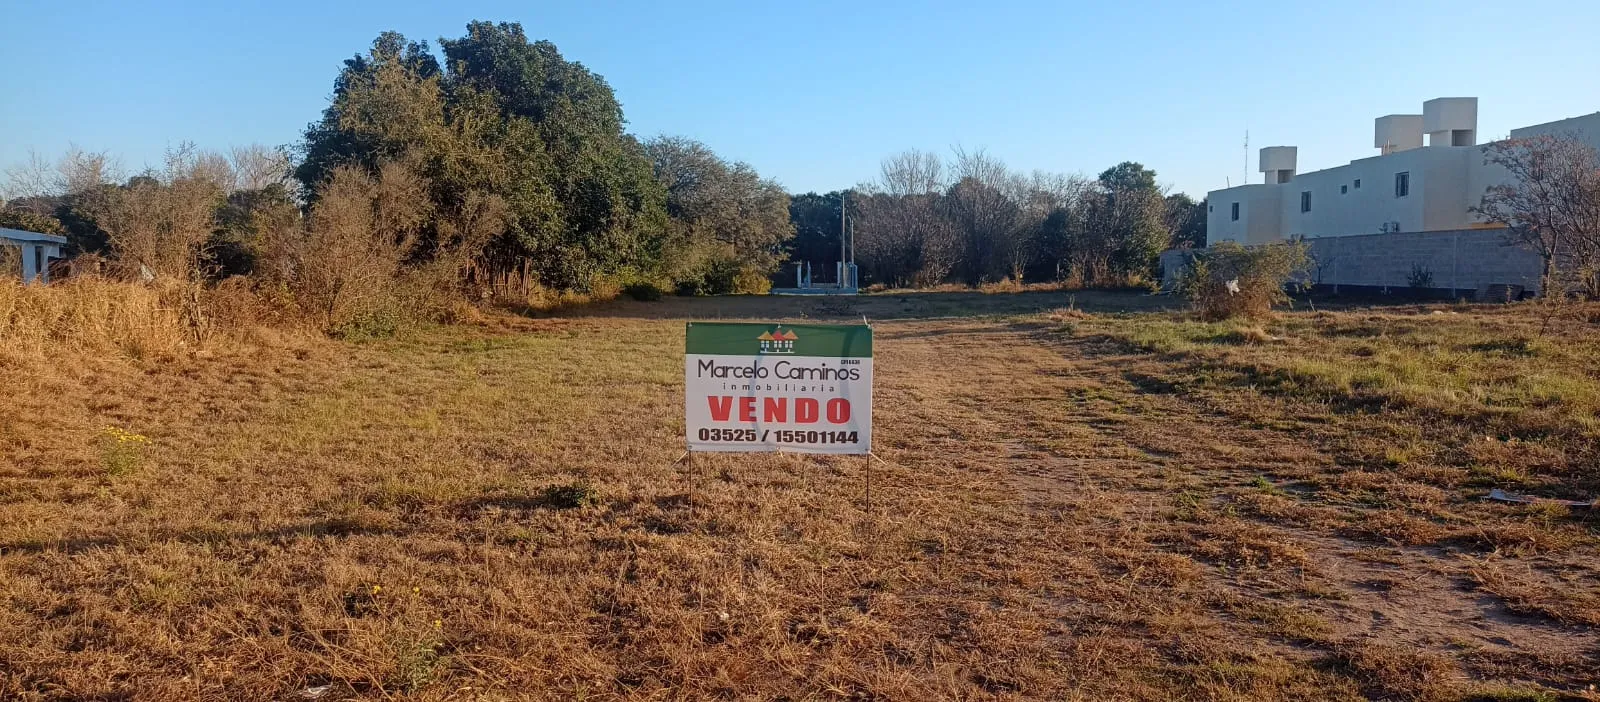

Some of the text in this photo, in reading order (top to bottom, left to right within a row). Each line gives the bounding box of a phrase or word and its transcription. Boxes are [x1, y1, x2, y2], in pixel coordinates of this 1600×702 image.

[698, 359, 860, 381] Marcelo Caminos
[723, 383, 835, 392] inmobiliaria
[707, 396, 851, 424] VENDO
[698, 428, 859, 444] 03525 / 15501144
